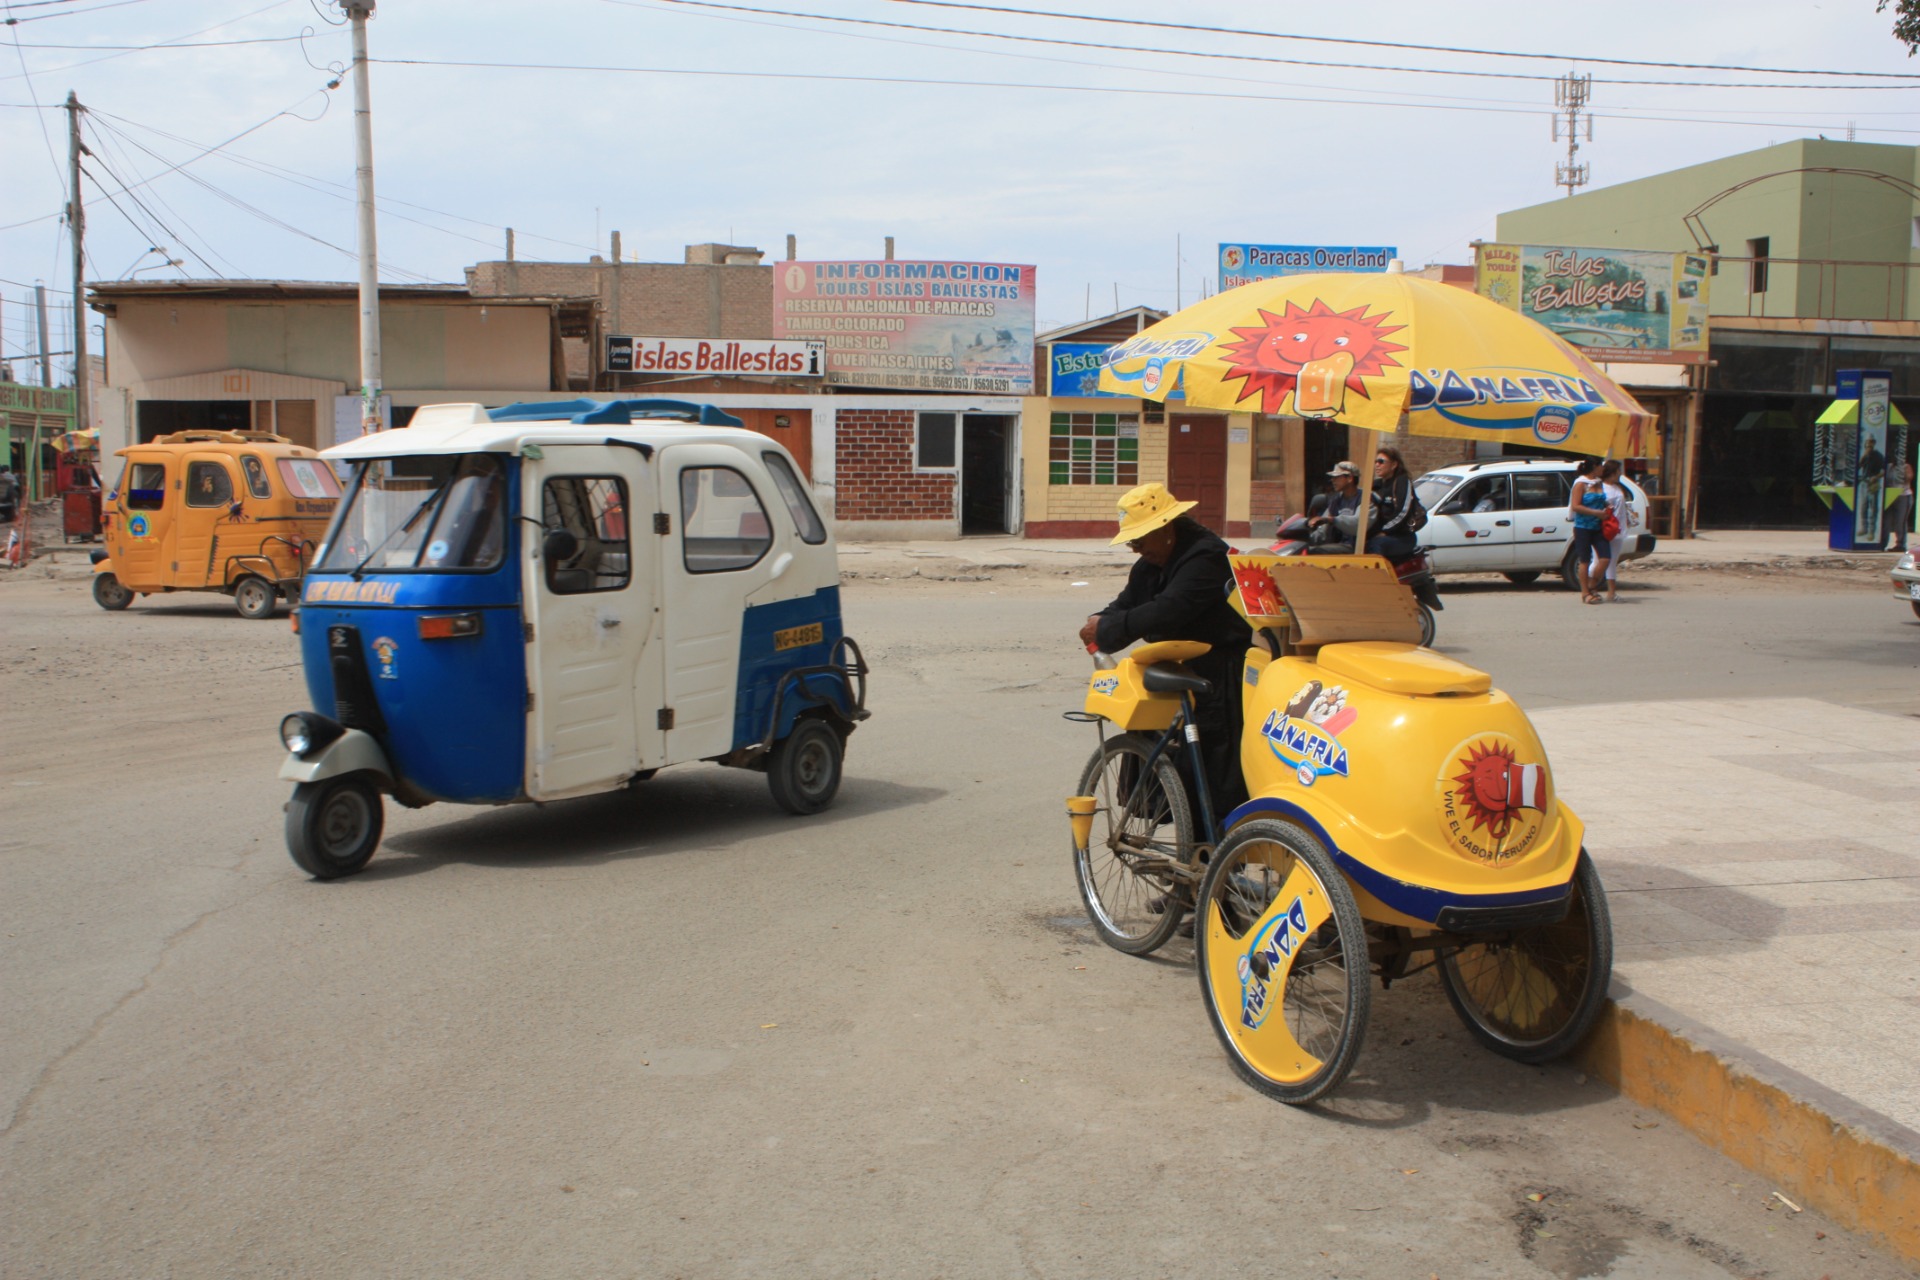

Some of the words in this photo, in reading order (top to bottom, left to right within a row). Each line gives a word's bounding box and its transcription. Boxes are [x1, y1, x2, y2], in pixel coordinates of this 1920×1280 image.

[1250, 247, 1310, 266] Paracas
[1314, 248, 1387, 267] Overland
[1545, 250, 1605, 278] Islas
[815, 263, 1021, 282] INFORMACION
[1486, 263, 1517, 273] TOURS
[816, 282, 869, 296] TOURS
[876, 282, 924, 297] ISLAS
[931, 283, 1019, 299] BALLESTAS
[1225, 275, 1251, 287] Islas
[1531, 279, 1646, 313] Ballestas
[785, 299, 844, 313] RESERVA
[846, 299, 912, 314] NACIONAL
[915, 300, 931, 315] DE
[934, 301, 995, 317] PARACAS
[785, 317, 832, 331] TAMBO
[834, 317, 905, 332] COLORADO
[806, 342, 824, 350] Free
[866, 336, 889, 350] ICA
[633, 341, 694, 371] islas
[695, 341, 804, 371] Ballestas
[832, 352, 867, 368] OVER
[869, 354, 914, 370] NASCA
[918, 355, 954, 371] LINES
[223, 374, 250, 393] 101
[1443, 790, 1456, 818] VIVE
[1449, 820, 1461, 836] EL
[1458, 835, 1493, 860] SABOR
[1499, 825, 1537, 859] PERUANO
